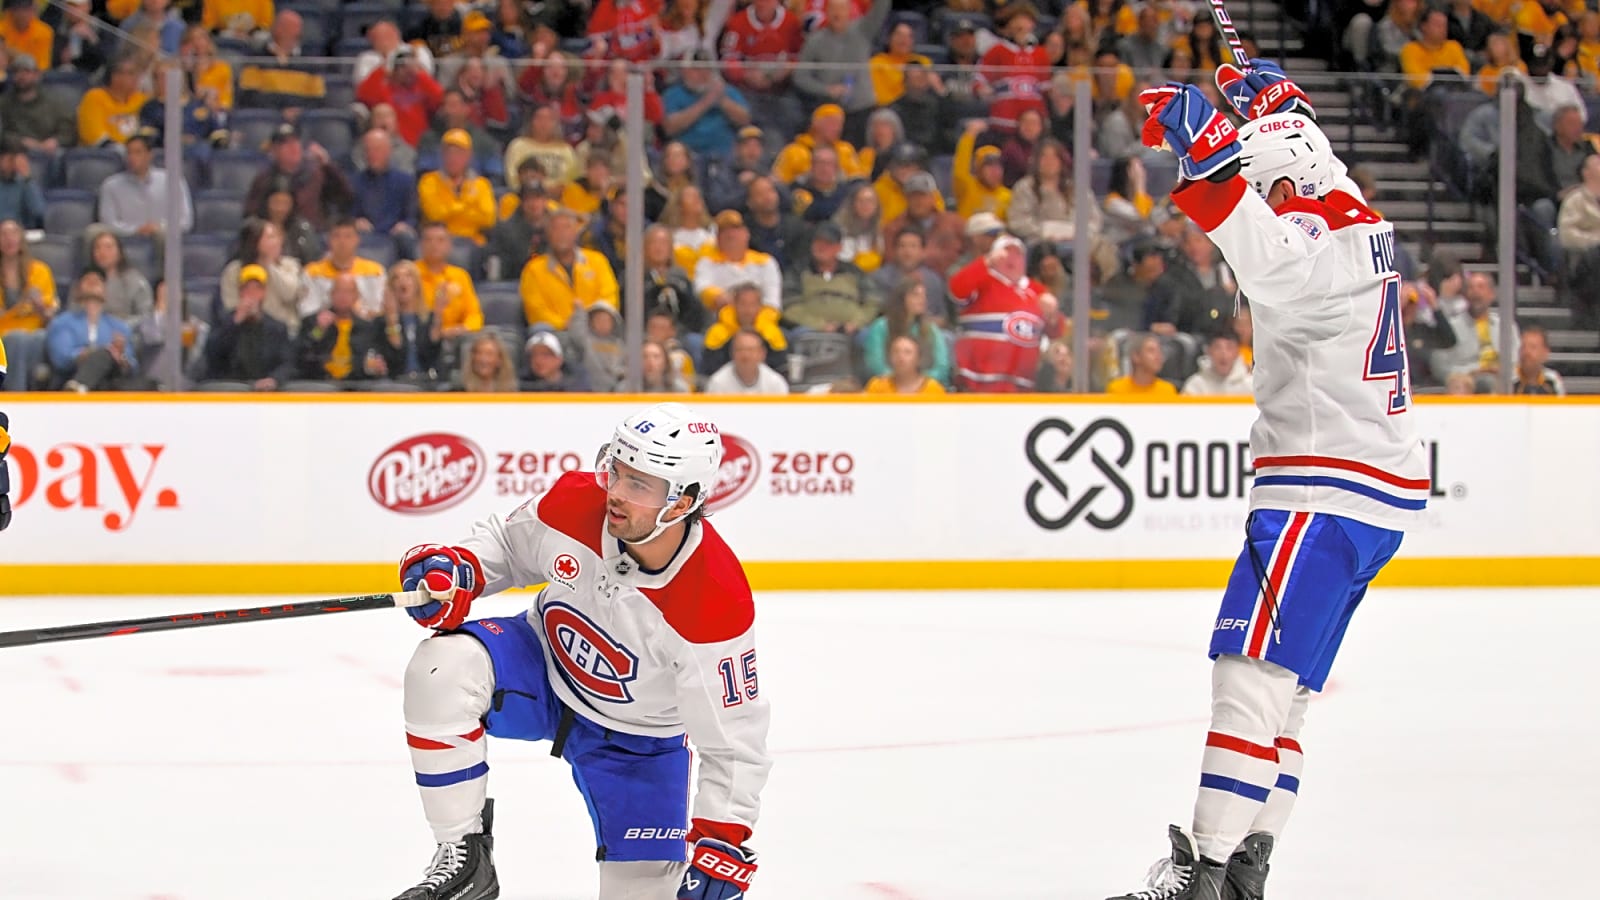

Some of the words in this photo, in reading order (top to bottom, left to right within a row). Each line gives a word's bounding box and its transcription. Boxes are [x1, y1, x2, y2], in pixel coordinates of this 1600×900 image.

[1259, 120, 1291, 133] CIBC
[1369, 231, 1393, 274] HU
[1362, 273, 1408, 415] 4
[634, 420, 656, 434] 15
[410, 442, 451, 474] Dr
[497, 452, 581, 474] zero
[771, 452, 854, 475] zero
[1146, 441, 1256, 498] COOP
[378, 450, 476, 507] Pepper
[496, 478, 547, 495] SUG
[771, 478, 854, 495] SUGAR
[718, 649, 758, 708] 15
[697, 852, 754, 884] BAU
